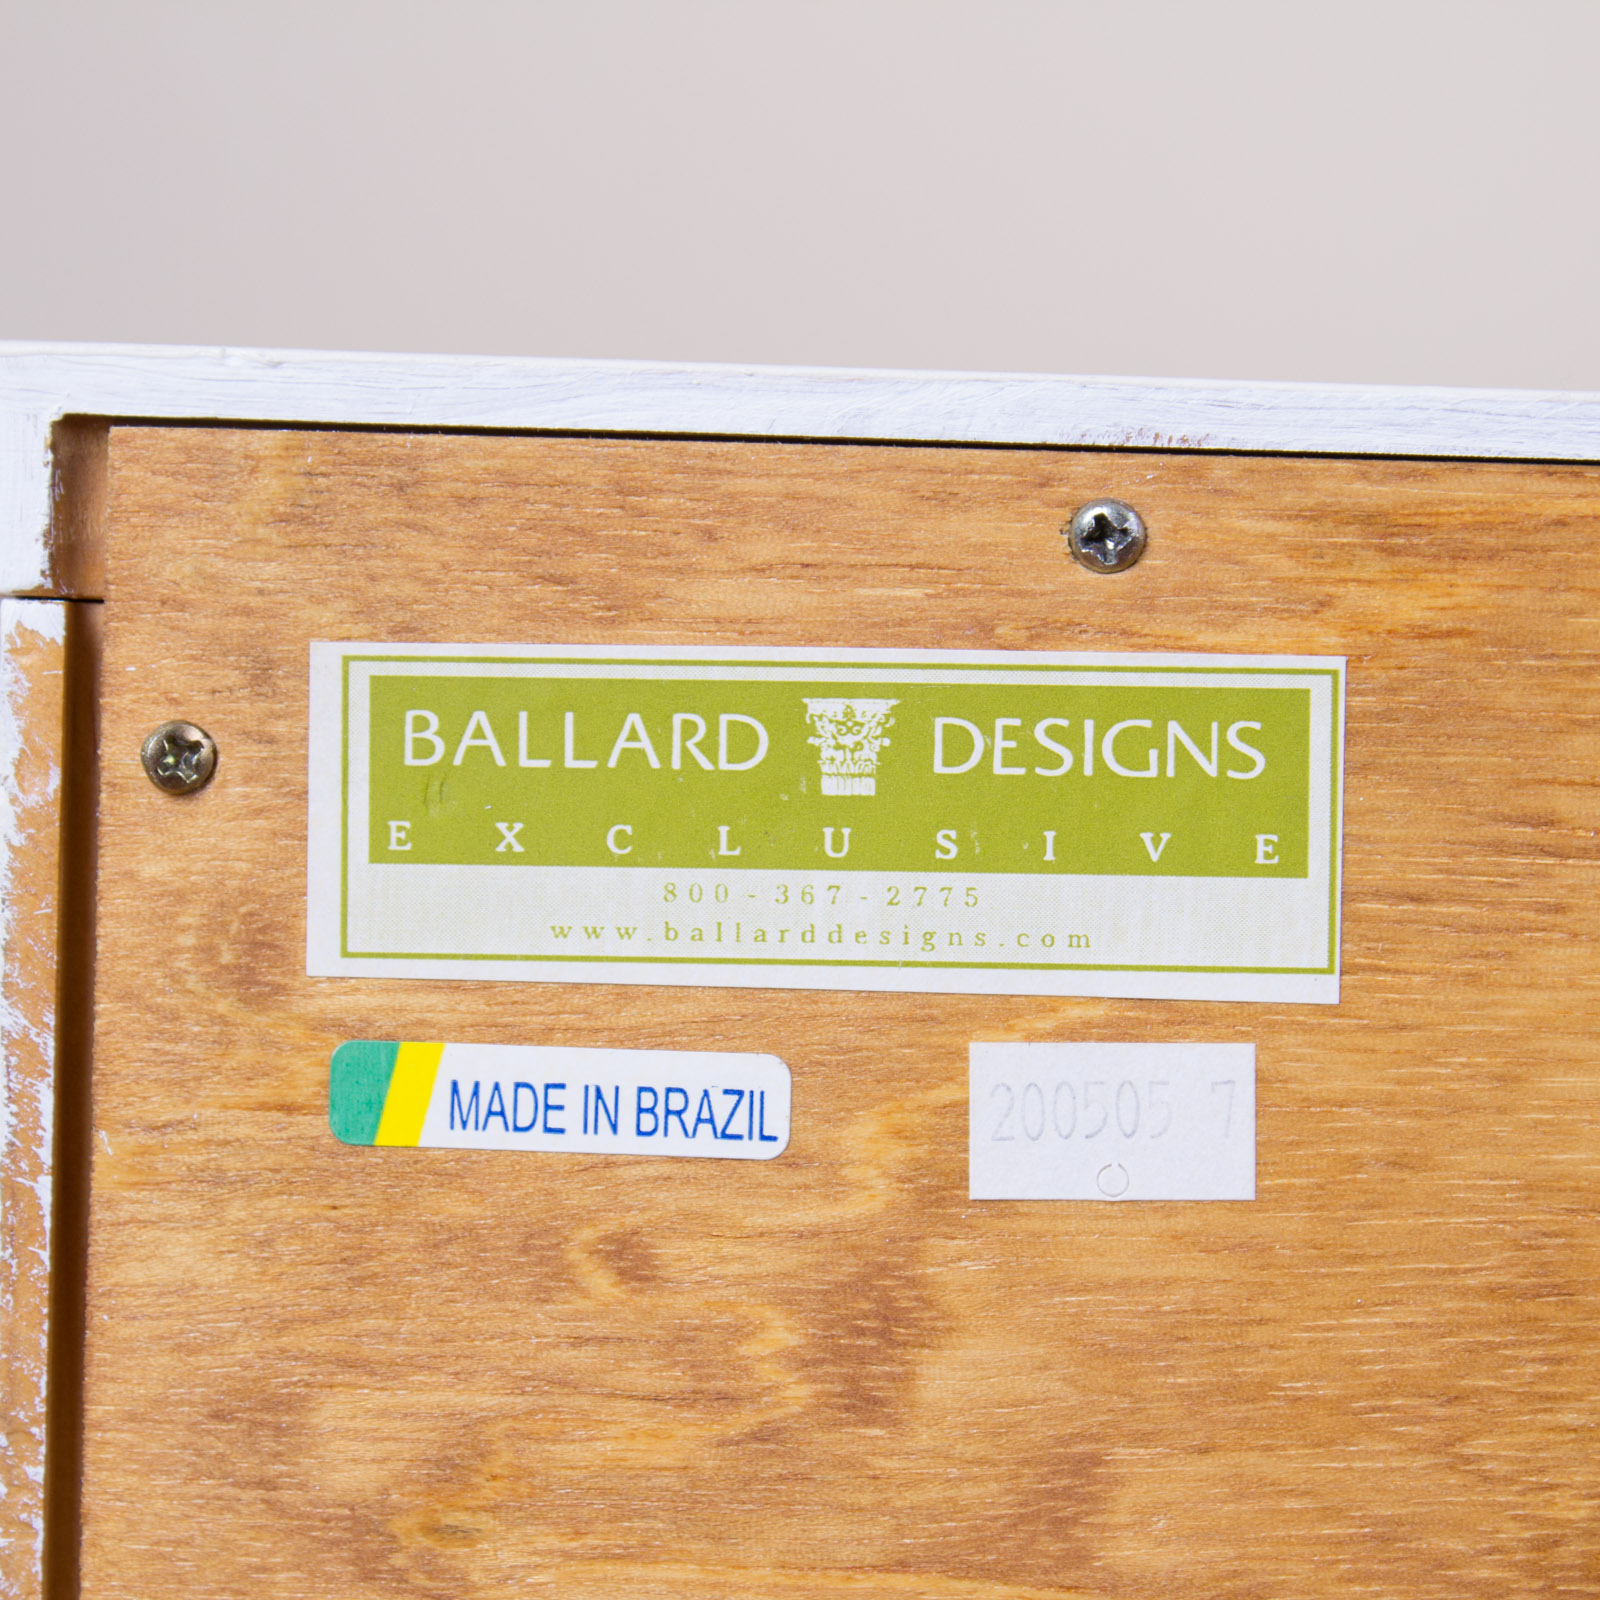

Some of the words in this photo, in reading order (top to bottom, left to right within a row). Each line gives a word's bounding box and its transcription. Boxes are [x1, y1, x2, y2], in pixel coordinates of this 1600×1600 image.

[403, 709, 770, 771] BALLARD
[934, 717, 1266, 780] DESIGNS
[550, 920, 1092, 951] www.ballarddesigns.com
[449, 1079, 566, 1133] MADE
[583, 1084, 619, 1136] IN
[636, 1086, 778, 1141] BRAZIL
